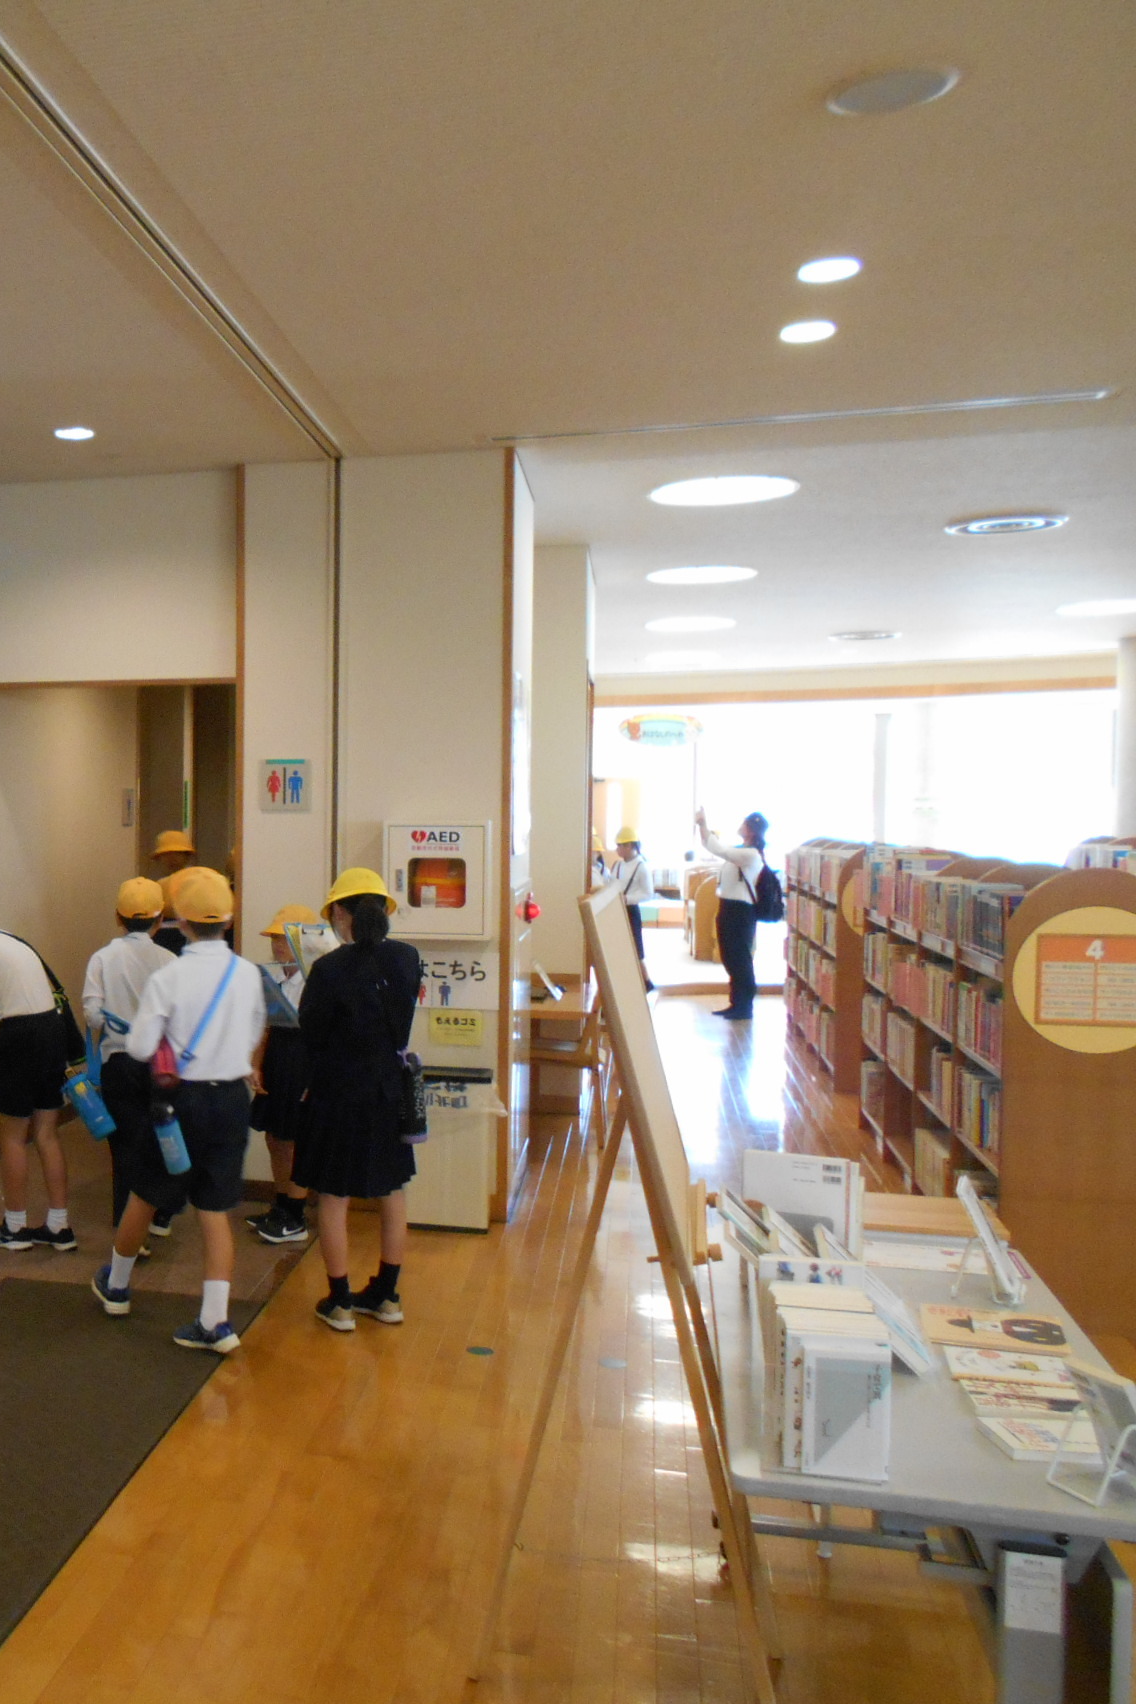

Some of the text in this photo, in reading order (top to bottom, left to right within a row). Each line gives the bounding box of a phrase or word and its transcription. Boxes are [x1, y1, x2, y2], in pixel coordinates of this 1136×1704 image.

[426, 831, 461, 843] AED
[1085, 938, 1105, 960] 4
[435, 1016, 477, 1027] もえるゴミ
